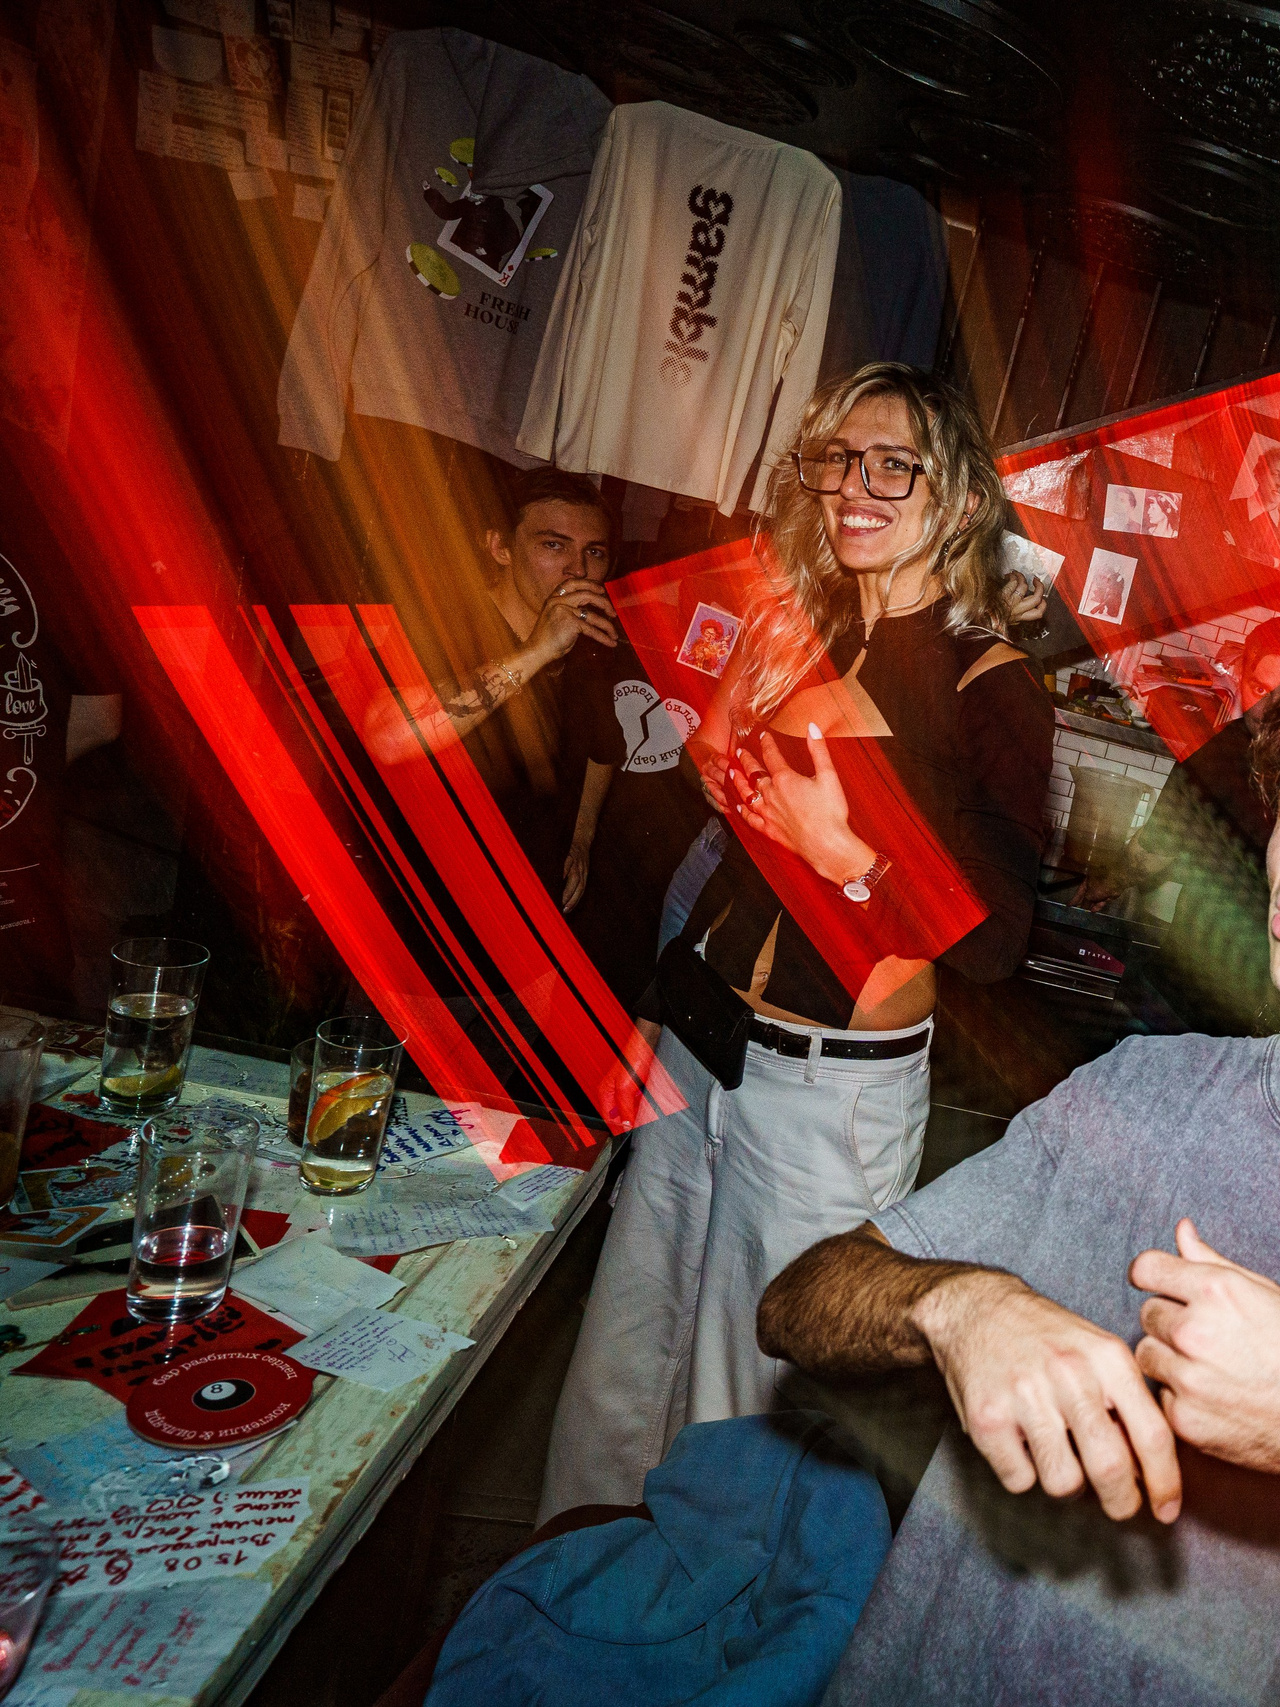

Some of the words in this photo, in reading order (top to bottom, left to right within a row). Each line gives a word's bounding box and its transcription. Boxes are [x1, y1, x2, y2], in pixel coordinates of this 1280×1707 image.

[464, 302, 519, 335] HOUSE
[479, 291, 531, 321] FRESH
[5, 691, 37, 715] love
[634, 755, 656, 766] бар
[152, 1368, 180, 1387] бар
[180, 1352, 261, 1371] разбитых
[261, 1354, 298, 1380] сердец
[210, 1384, 223, 1394] 8
[144, 1408, 198, 1441] бильярд
[218, 1402, 291, 1438] коктейли
